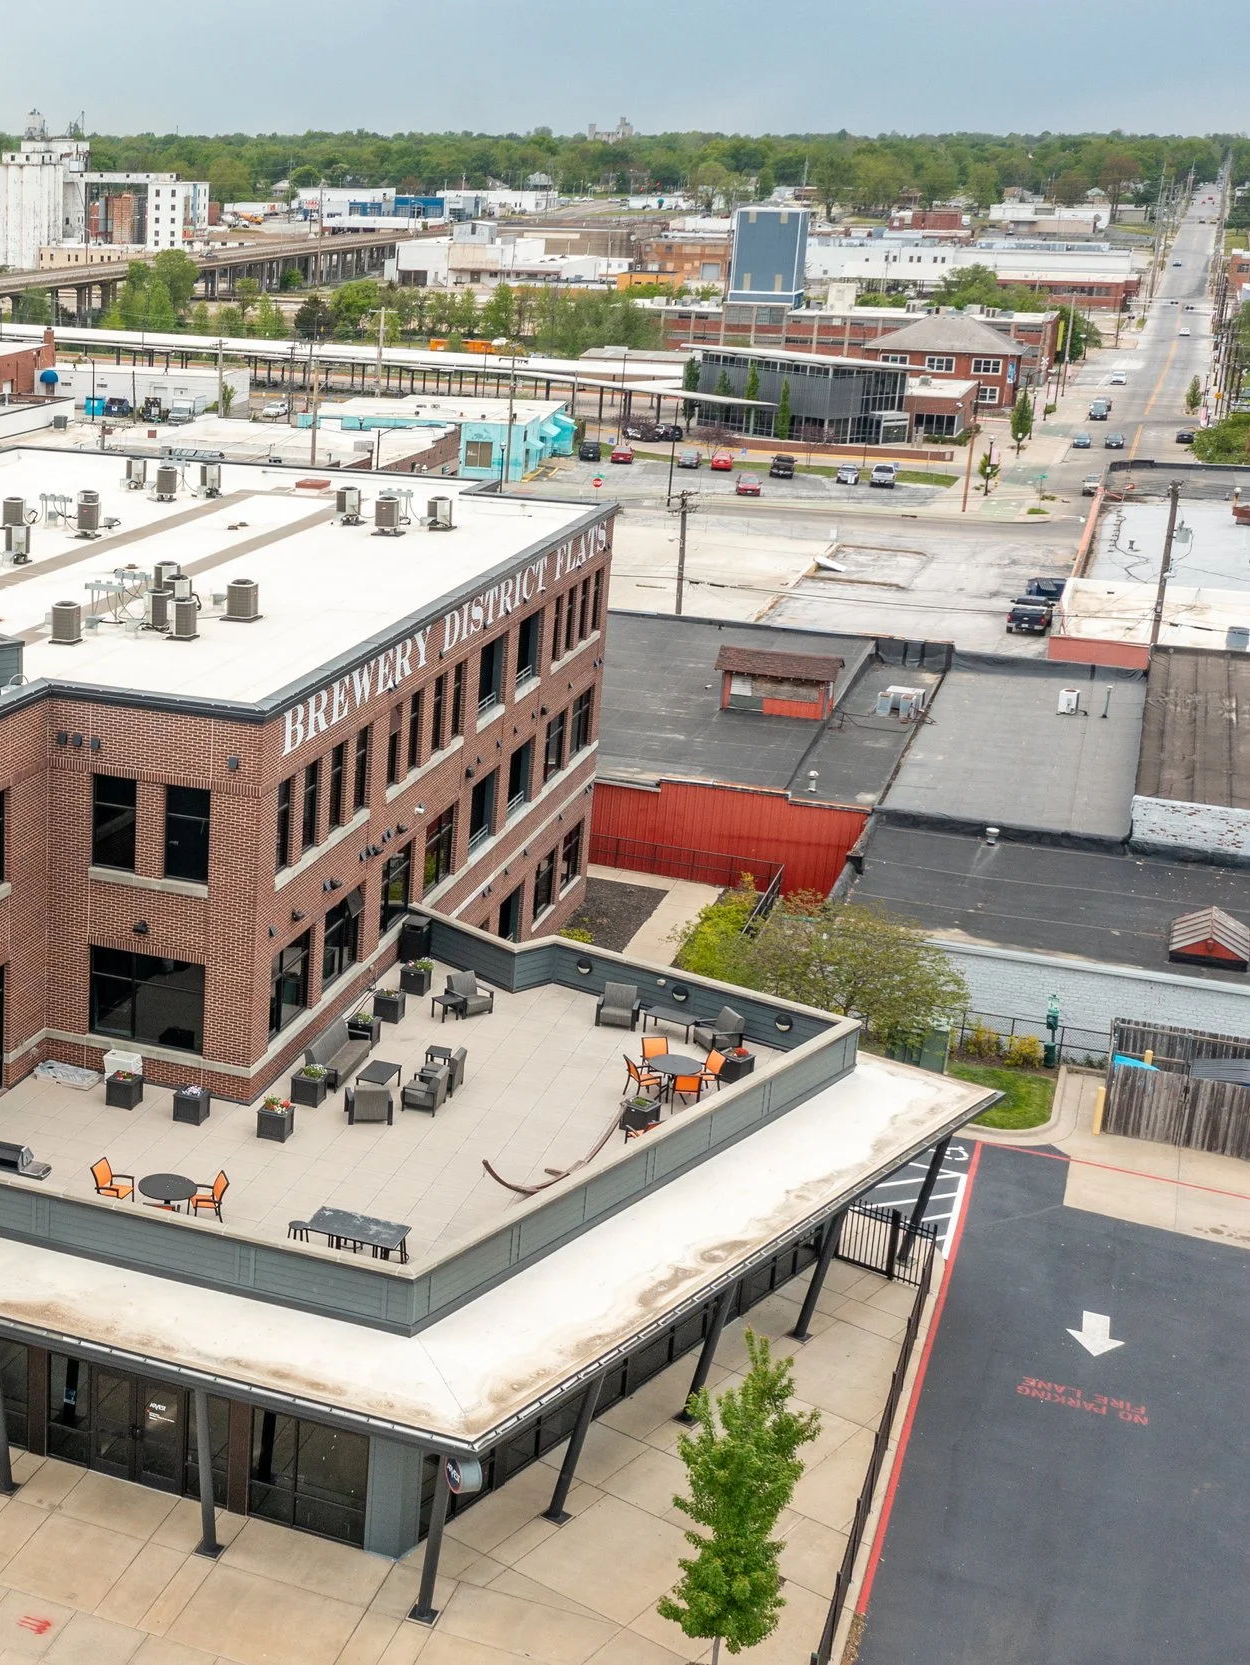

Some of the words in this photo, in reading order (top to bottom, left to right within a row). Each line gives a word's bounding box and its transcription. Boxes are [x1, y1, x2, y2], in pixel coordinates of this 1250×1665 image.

[281, 624, 432, 757] BREWERY
[442, 556, 548, 652] DISTRICT
[554, 520, 607, 581] FLATS
[1021, 1375, 1082, 1398] LANE
[1016, 1384, 1107, 1415] PARKING
[1094, 1392, 1146, 1414] FIRE
[1118, 1410, 1149, 1425] NO
